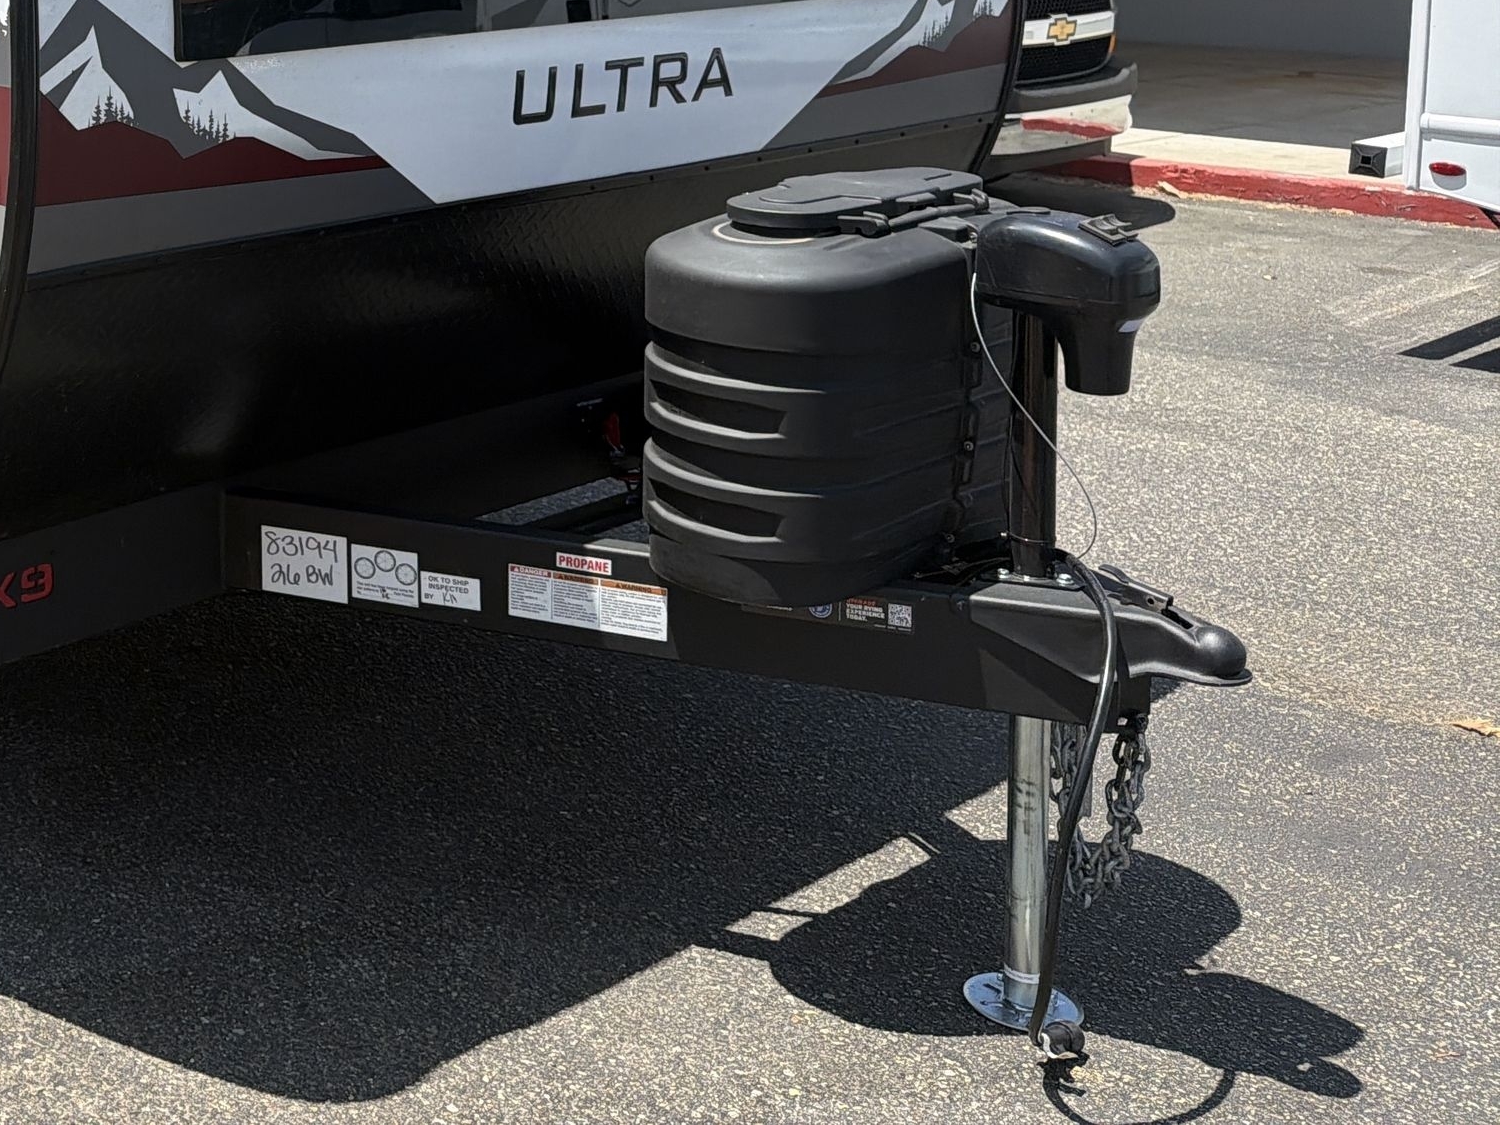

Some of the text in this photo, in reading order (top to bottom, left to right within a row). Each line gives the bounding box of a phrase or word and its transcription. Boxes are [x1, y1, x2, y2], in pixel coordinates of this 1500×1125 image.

[512, 47, 734, 126] ULTRA
[264, 530, 339, 564] 83194
[558, 555, 610, 573] PROPANE
[519, 566, 550, 578] DANGER
[428, 575, 469, 586] OK TO SHIP
[428, 582, 469, 594] INSPECTED
[620, 582, 653, 594] WARNING
[424, 592, 434, 600] BY
[846, 608, 886, 620] EXPERIENCE
